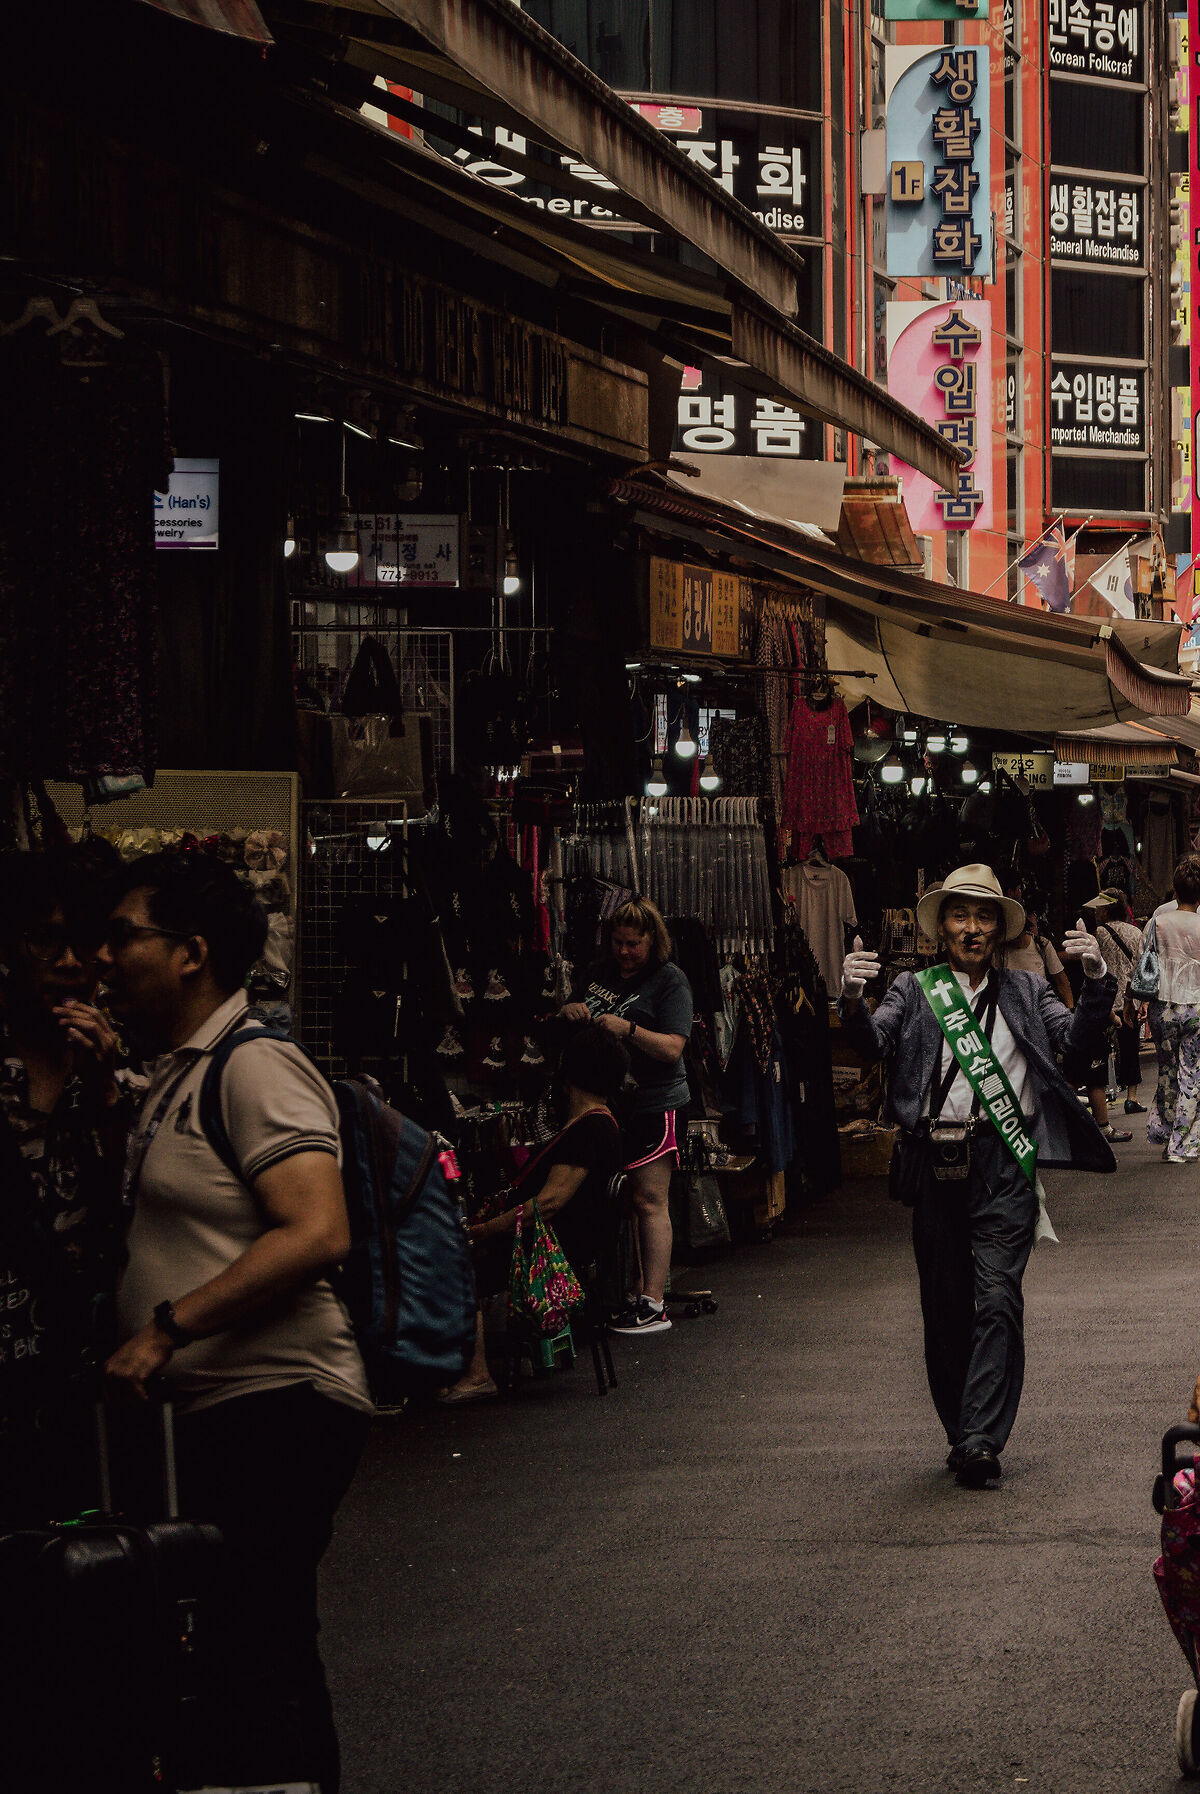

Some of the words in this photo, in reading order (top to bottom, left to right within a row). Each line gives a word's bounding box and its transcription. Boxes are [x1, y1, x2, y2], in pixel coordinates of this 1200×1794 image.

[1050, 0, 1138, 56] 민속공예
[894, 166, 921, 195] 1F
[930, 50, 982, 269] 생활잡화
[1050, 184, 1139, 240] 생활잡화
[1050, 236, 1082, 255] General
[1086, 240, 1139, 262] Merchandise
[678, 394, 805, 455] 명품
[932, 309, 984, 521] 수입명품
[1051, 371, 1140, 424] 수입명품
[1089, 426, 1140, 445] Merchandise
[168, 494, 211, 510] (Han's)
